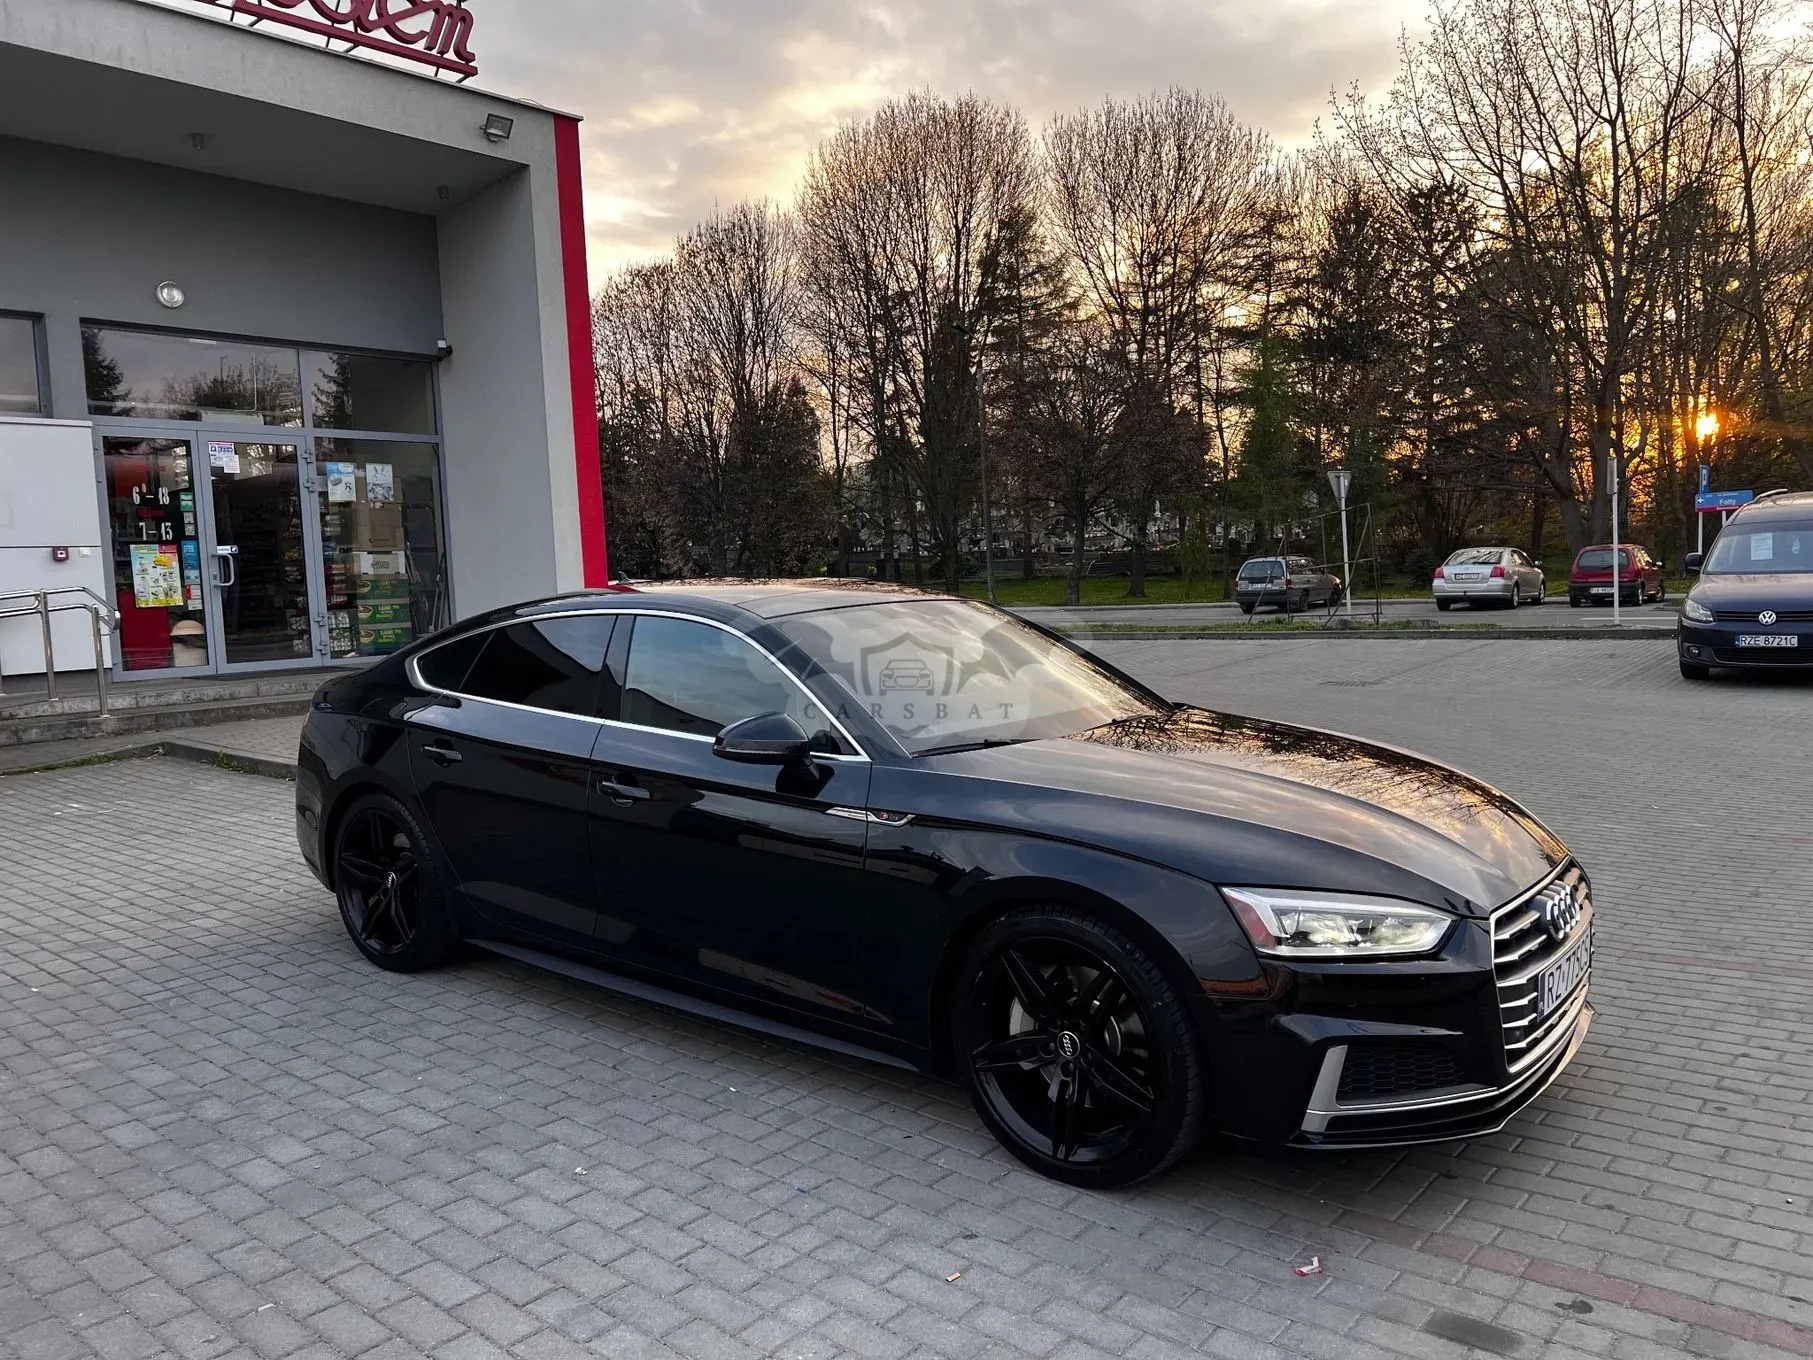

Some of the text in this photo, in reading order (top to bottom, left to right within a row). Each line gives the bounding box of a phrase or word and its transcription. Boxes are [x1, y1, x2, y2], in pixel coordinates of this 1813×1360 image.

[158, 486, 170, 505] 18
[139, 521, 147, 541] 7
[161, 522, 173, 541] 13
[1741, 636, 1797, 646] RZE 8721C
[1547, 963, 1562, 1008] RZ
